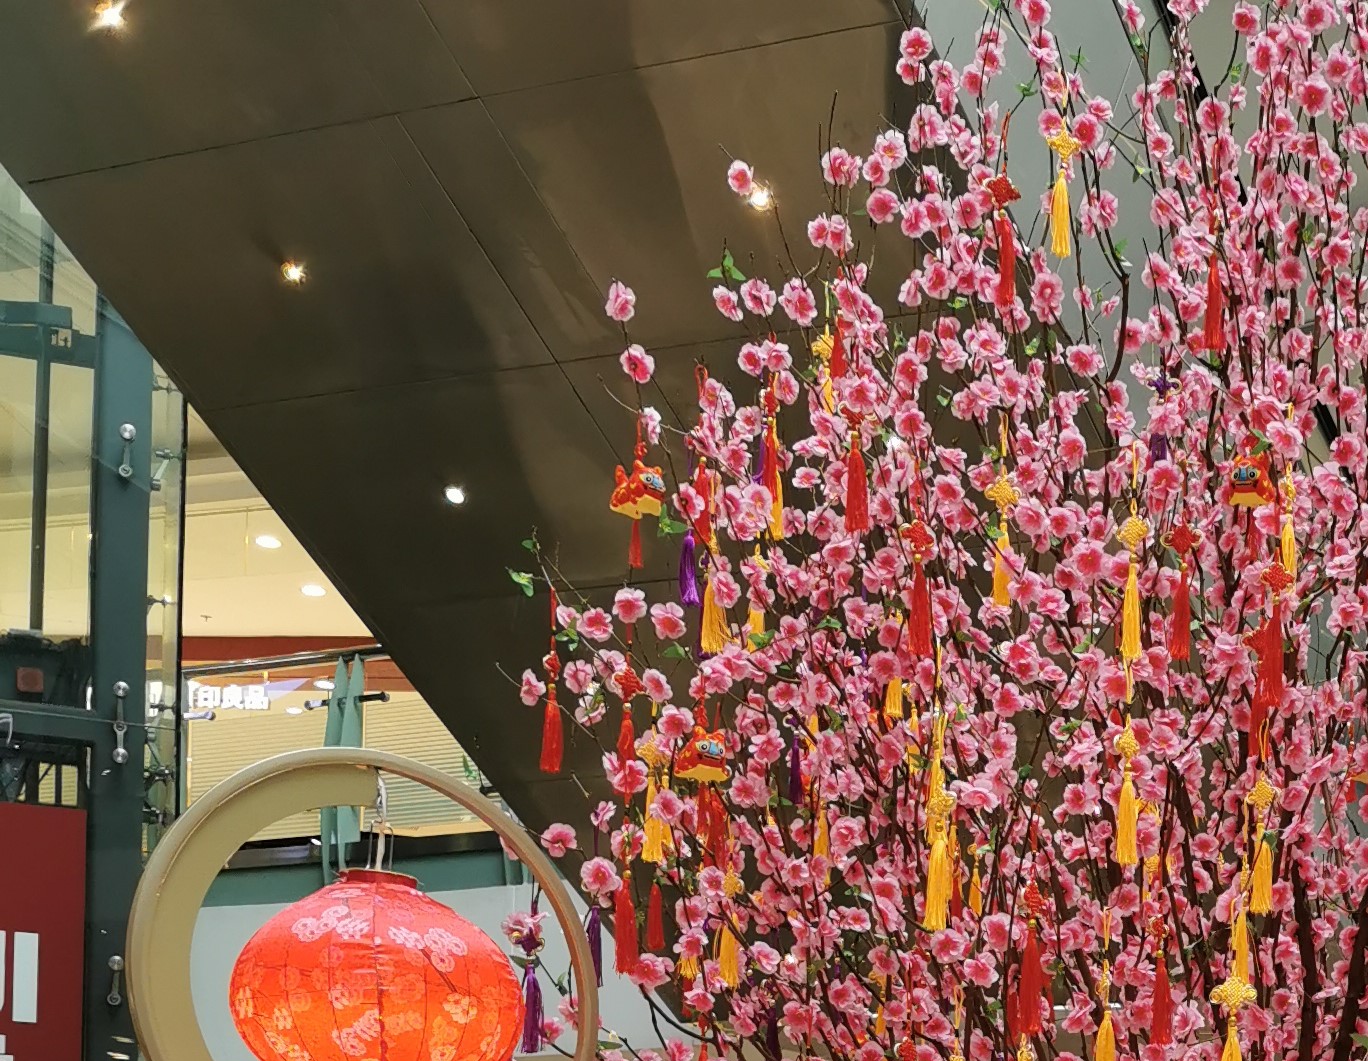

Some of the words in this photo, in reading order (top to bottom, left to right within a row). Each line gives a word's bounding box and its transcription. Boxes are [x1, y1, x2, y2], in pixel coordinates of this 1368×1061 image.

[187, 682, 269, 709] 印良品
[0, 930, 39, 1023] I
